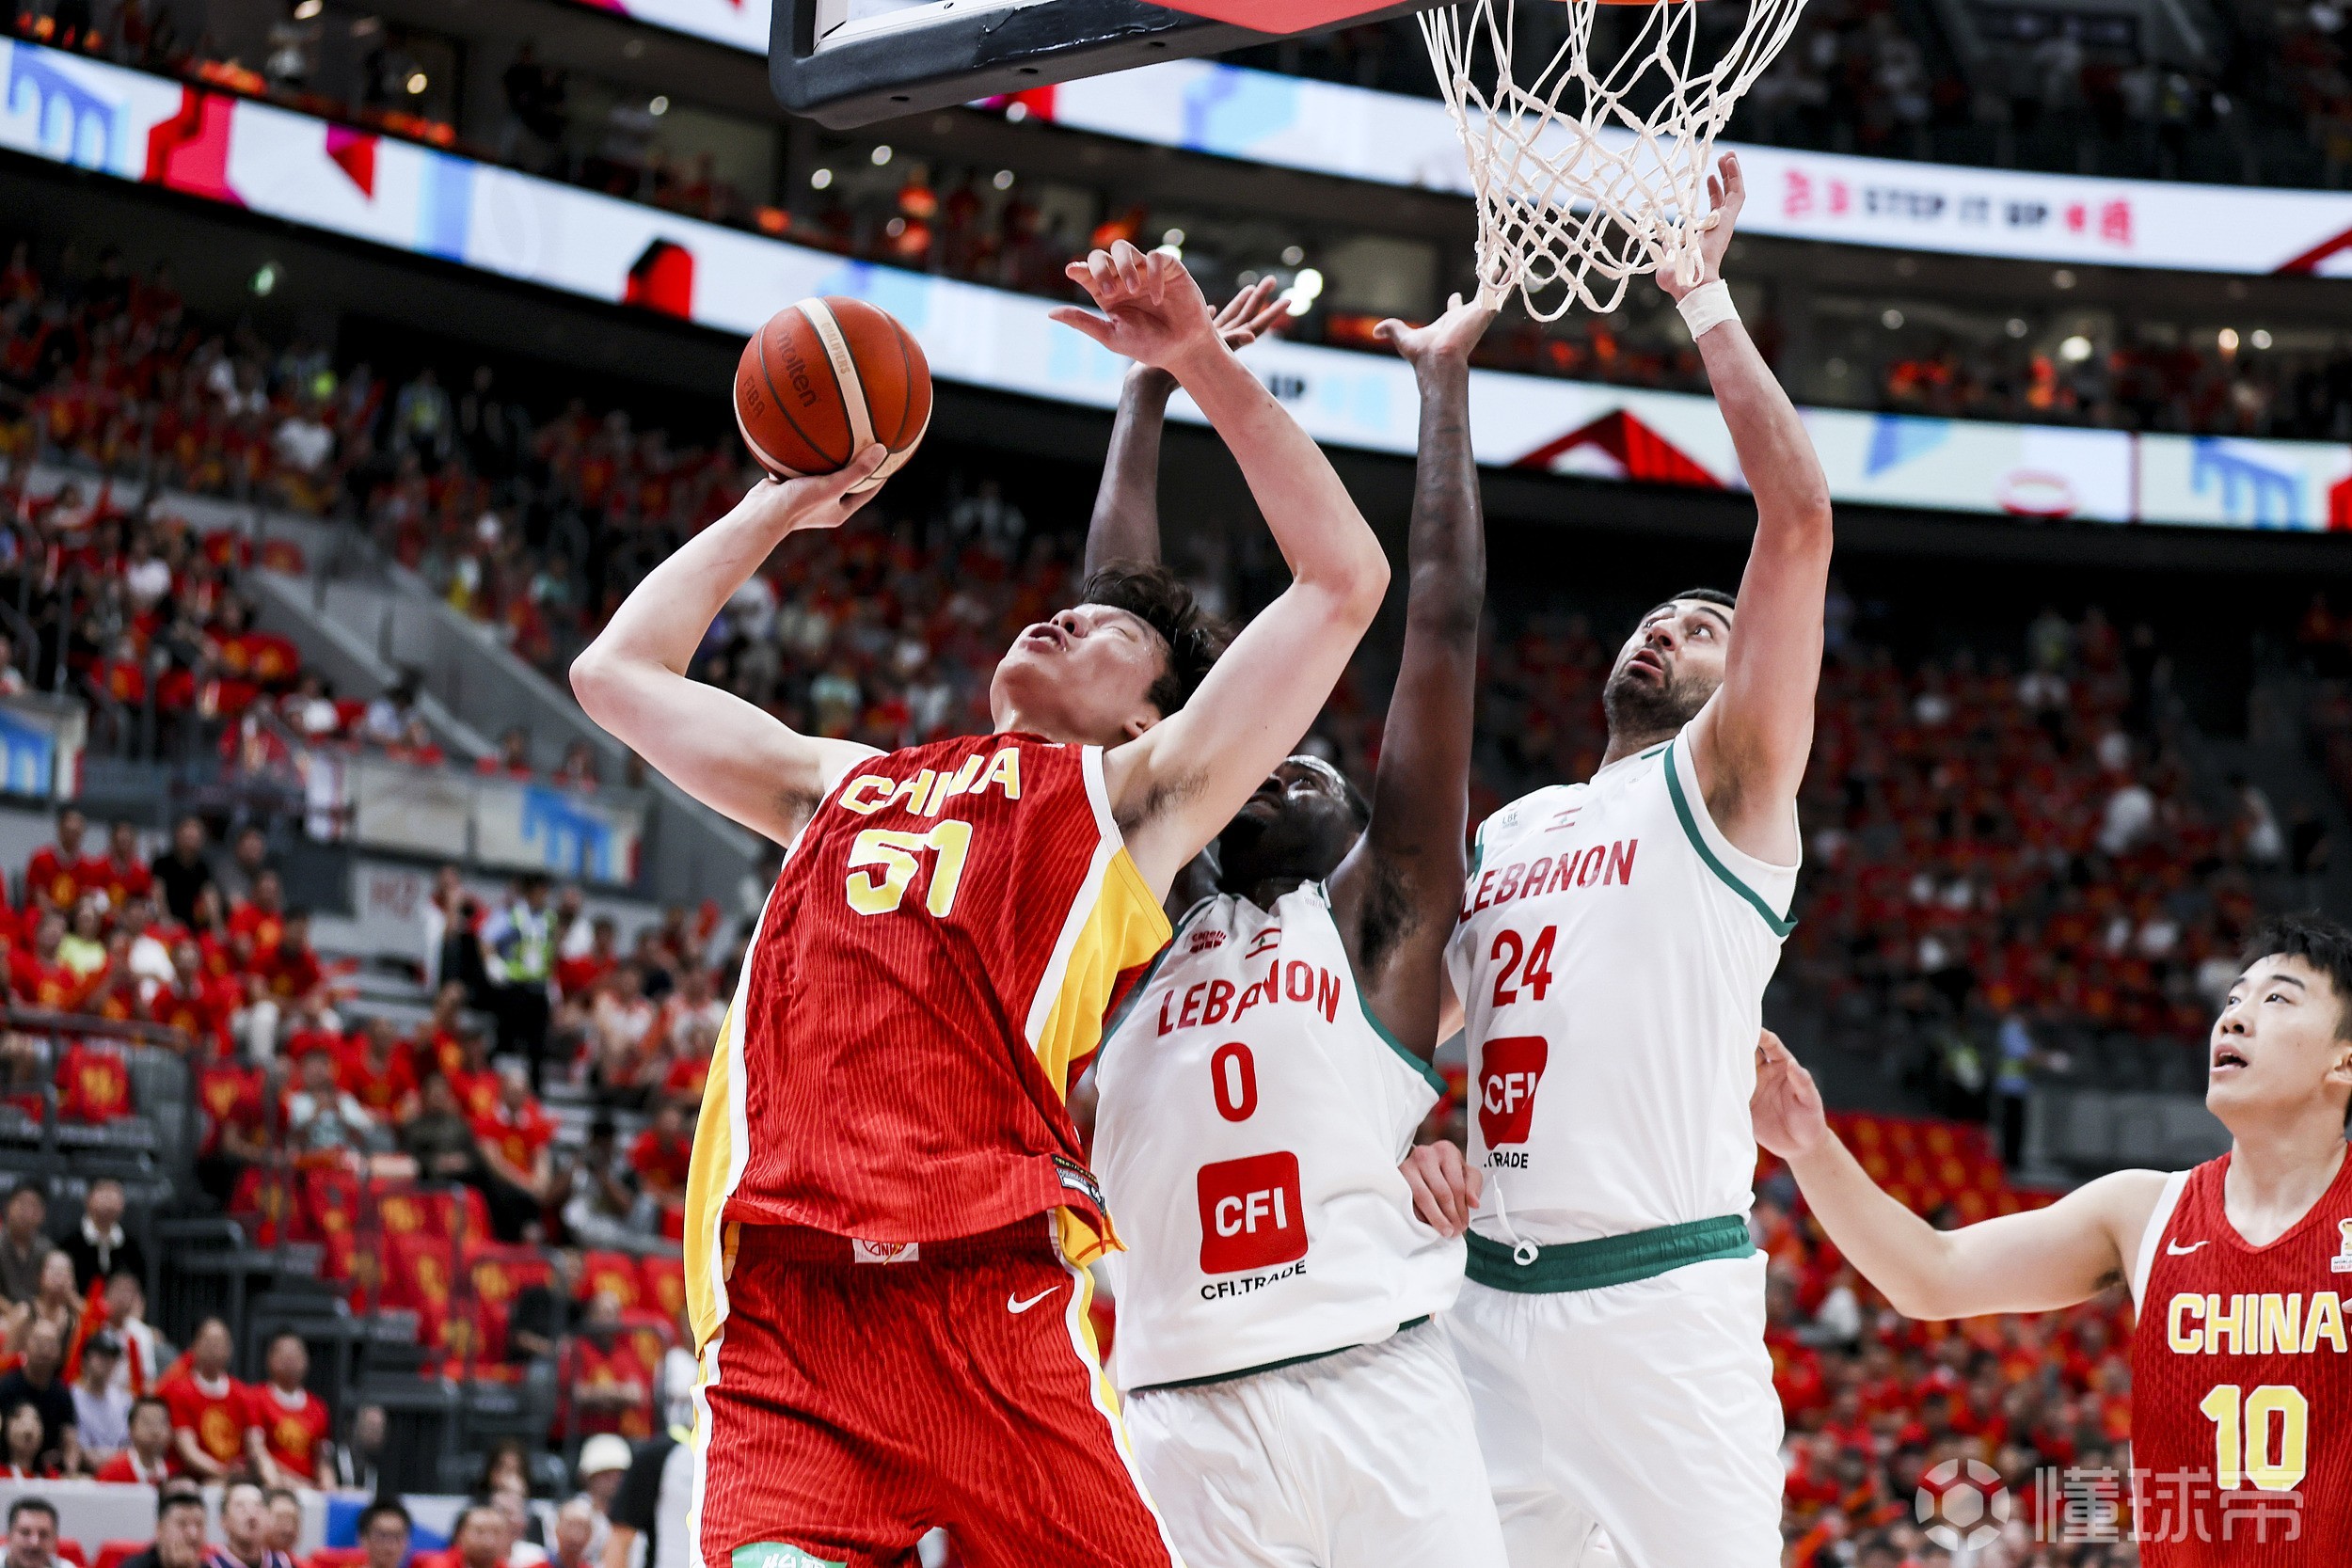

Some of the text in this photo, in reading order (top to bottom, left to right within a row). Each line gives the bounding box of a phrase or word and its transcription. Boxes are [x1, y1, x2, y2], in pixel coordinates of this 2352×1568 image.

[2004, 198, 2049, 229] UP
[776, 329, 818, 408] molten
[821, 322, 850, 375] QUALIFIERS
[743, 376, 766, 420] FIBA
[838, 747, 1020, 817] CHINA
[846, 819, 973, 918] 51
[1459, 839, 1639, 925] LEBANON
[1157, 959, 1341, 1037] LEBANON
[1490, 925, 1558, 1008] 24
[1211, 1041, 1258, 1122] 0
[1485, 1071, 1537, 1115] CFI
[1215, 1187, 1288, 1237] CFI
[1200, 1259, 1307, 1300] CFI.TRADE
[2168, 1291, 2348, 1354] CHINA
[2200, 1385, 2308, 1492] 10
